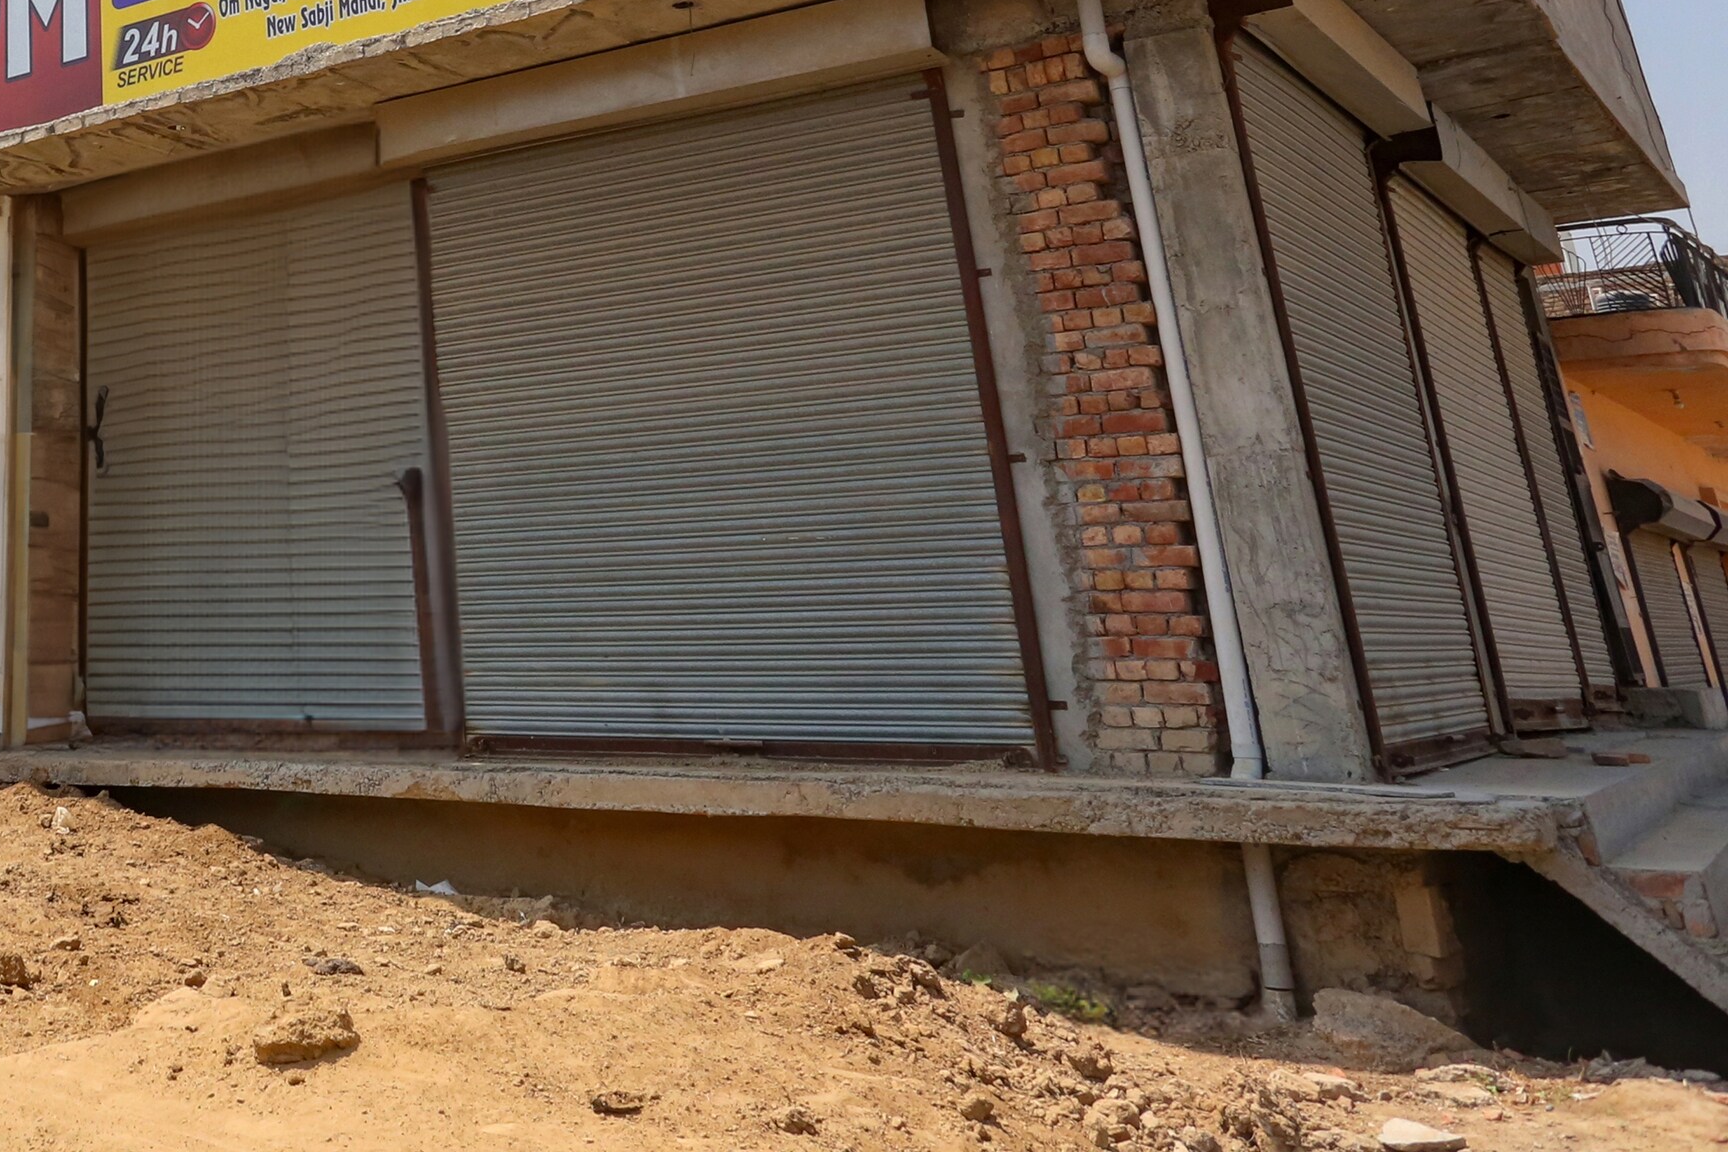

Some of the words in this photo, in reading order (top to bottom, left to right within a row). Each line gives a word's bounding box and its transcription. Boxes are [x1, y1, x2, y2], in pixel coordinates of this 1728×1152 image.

[265, 14, 297, 39] New
[301, 0, 335, 29] Sabji
[122, 20, 178, 65] 24h
[116, 55, 185, 89] SERVICE
